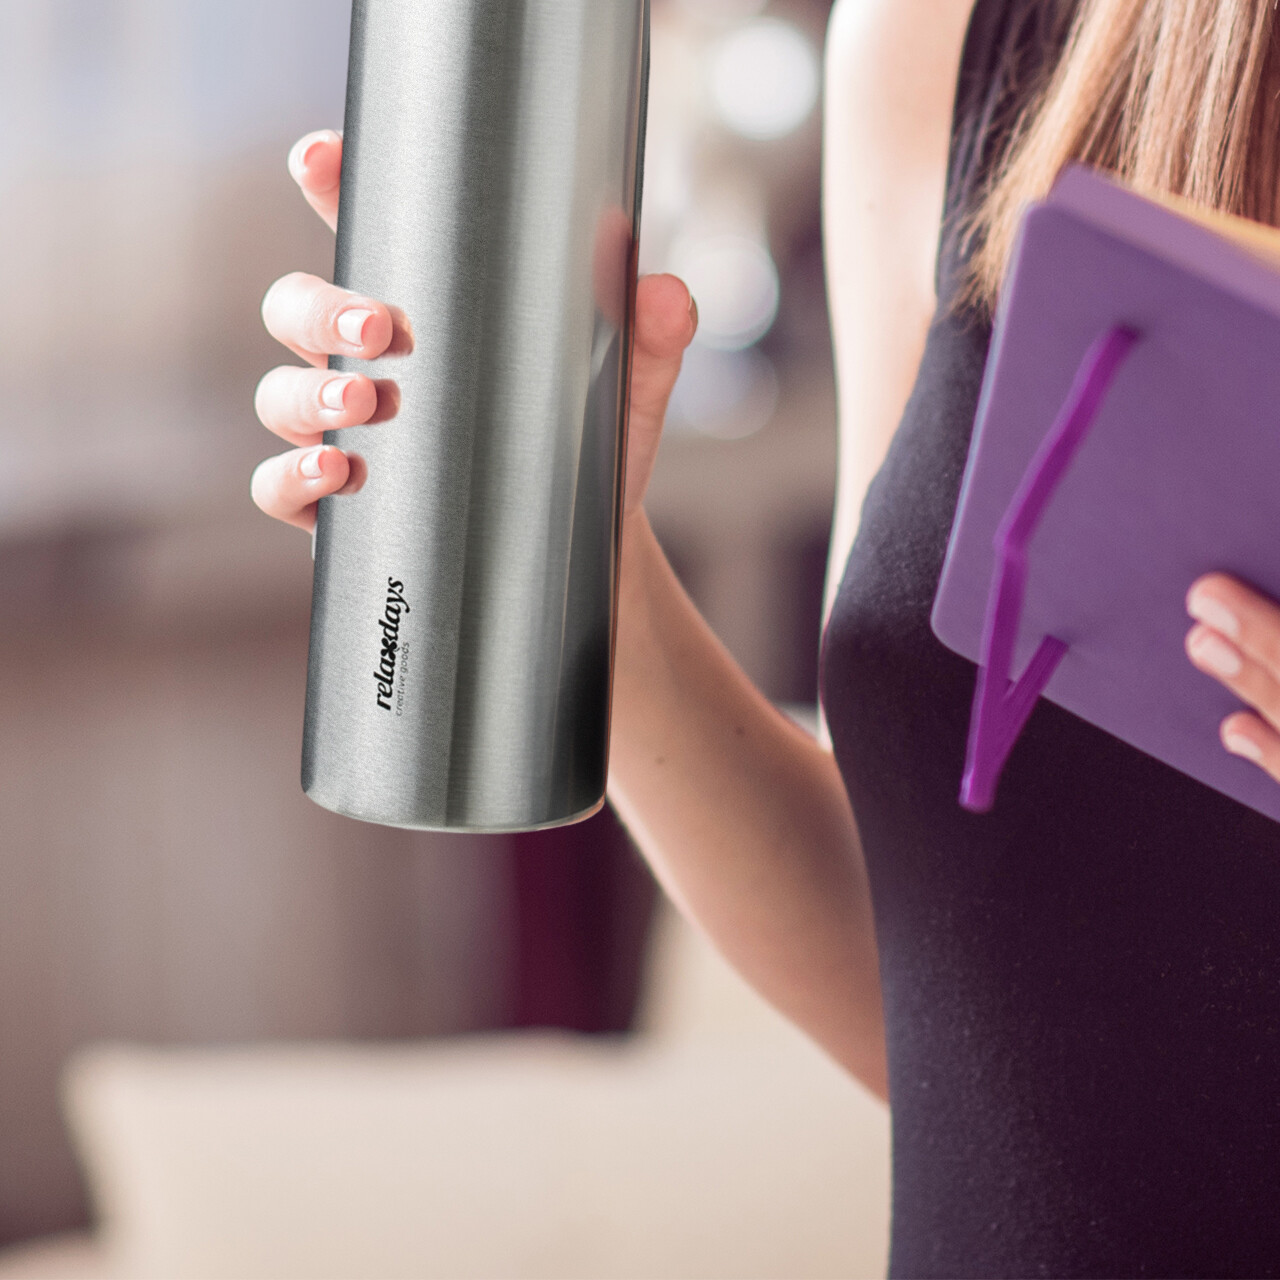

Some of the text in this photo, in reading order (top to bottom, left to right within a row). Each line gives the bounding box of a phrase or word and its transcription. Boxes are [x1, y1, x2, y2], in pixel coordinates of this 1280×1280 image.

[373, 576, 410, 711] relaxdays
[396, 641, 410, 717] creative goods
